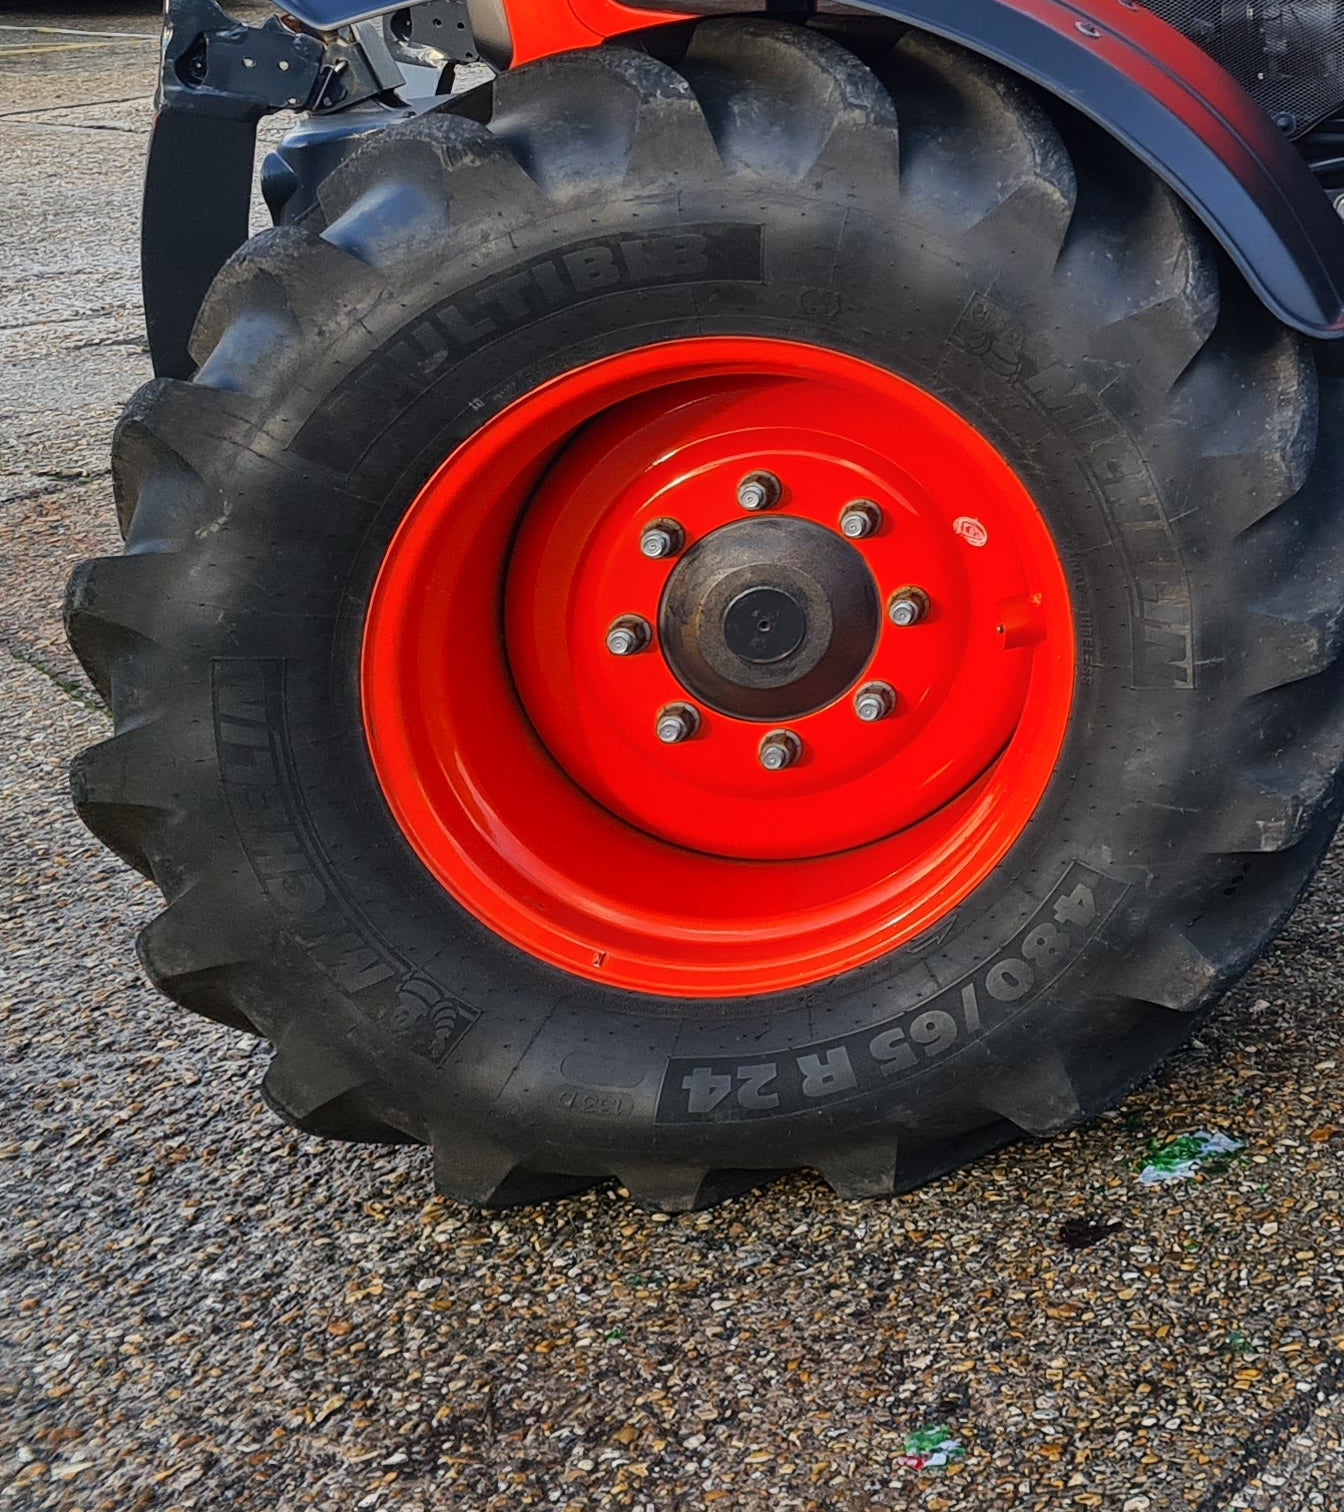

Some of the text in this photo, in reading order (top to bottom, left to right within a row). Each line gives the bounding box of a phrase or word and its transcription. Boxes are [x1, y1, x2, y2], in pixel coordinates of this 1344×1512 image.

[681, 881, 1098, 1114] 480/65 R 24
